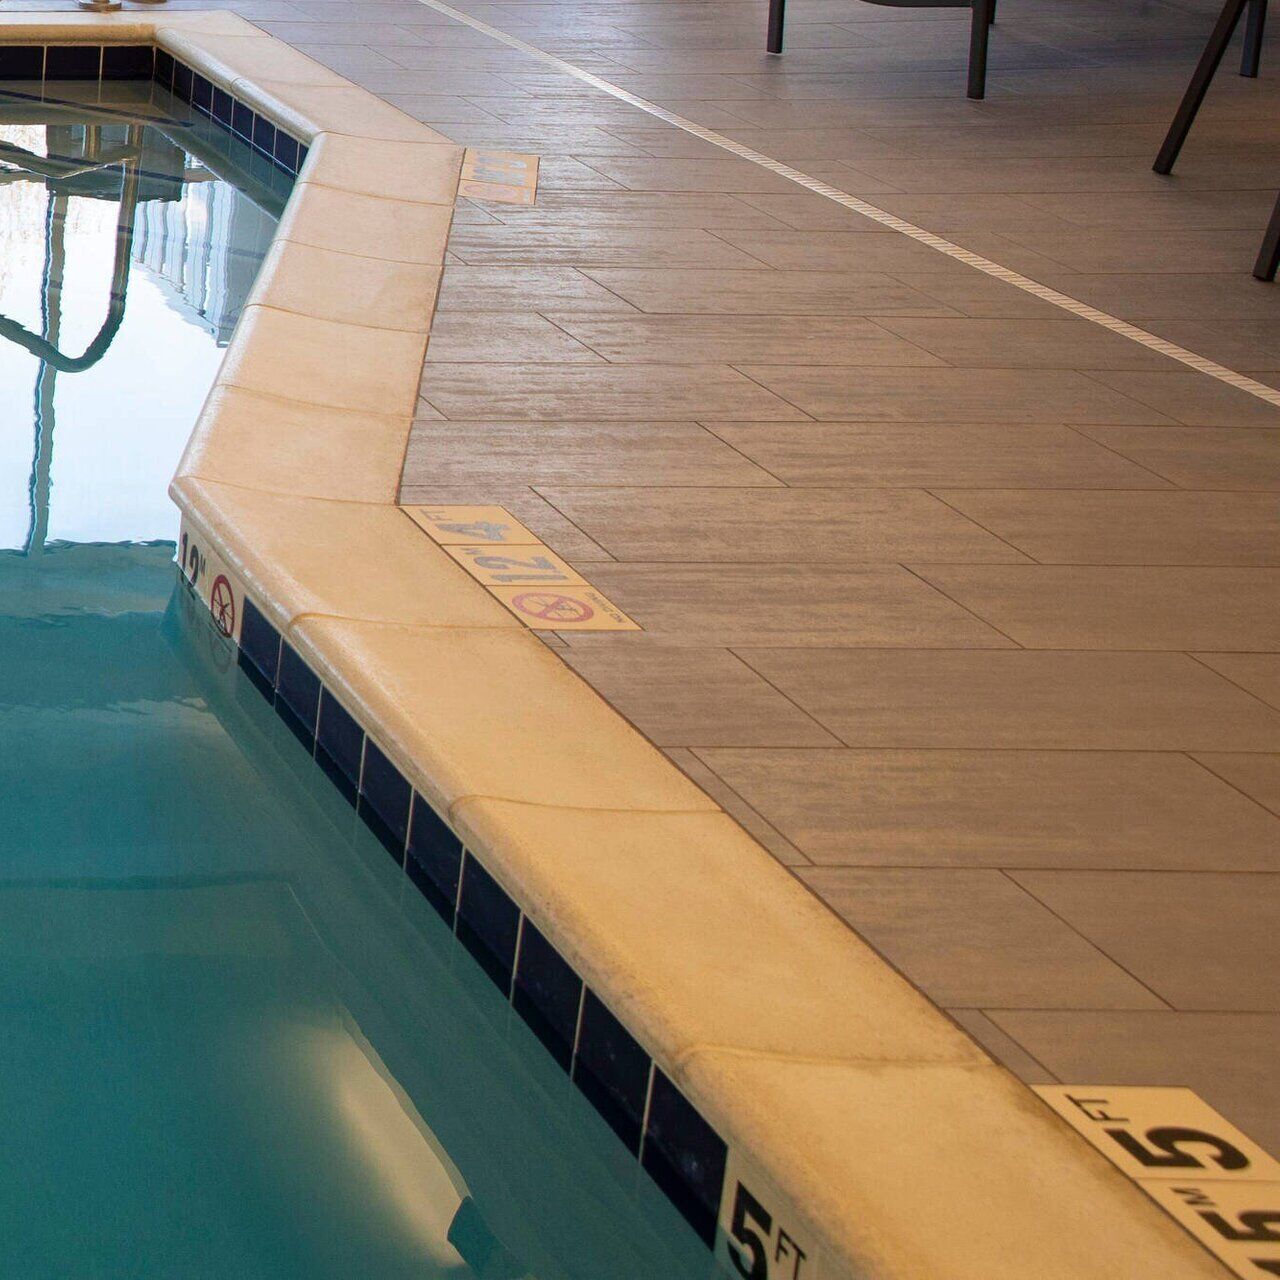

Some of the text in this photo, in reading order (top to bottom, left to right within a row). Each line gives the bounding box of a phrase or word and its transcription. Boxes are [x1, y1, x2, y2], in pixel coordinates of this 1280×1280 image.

[434, 521, 511, 541] 4
[1063, 1092, 1251, 1171] 5 FT
[1170, 1187, 1217, 1206] M
[729, 1179, 808, 1280] 5 FT
